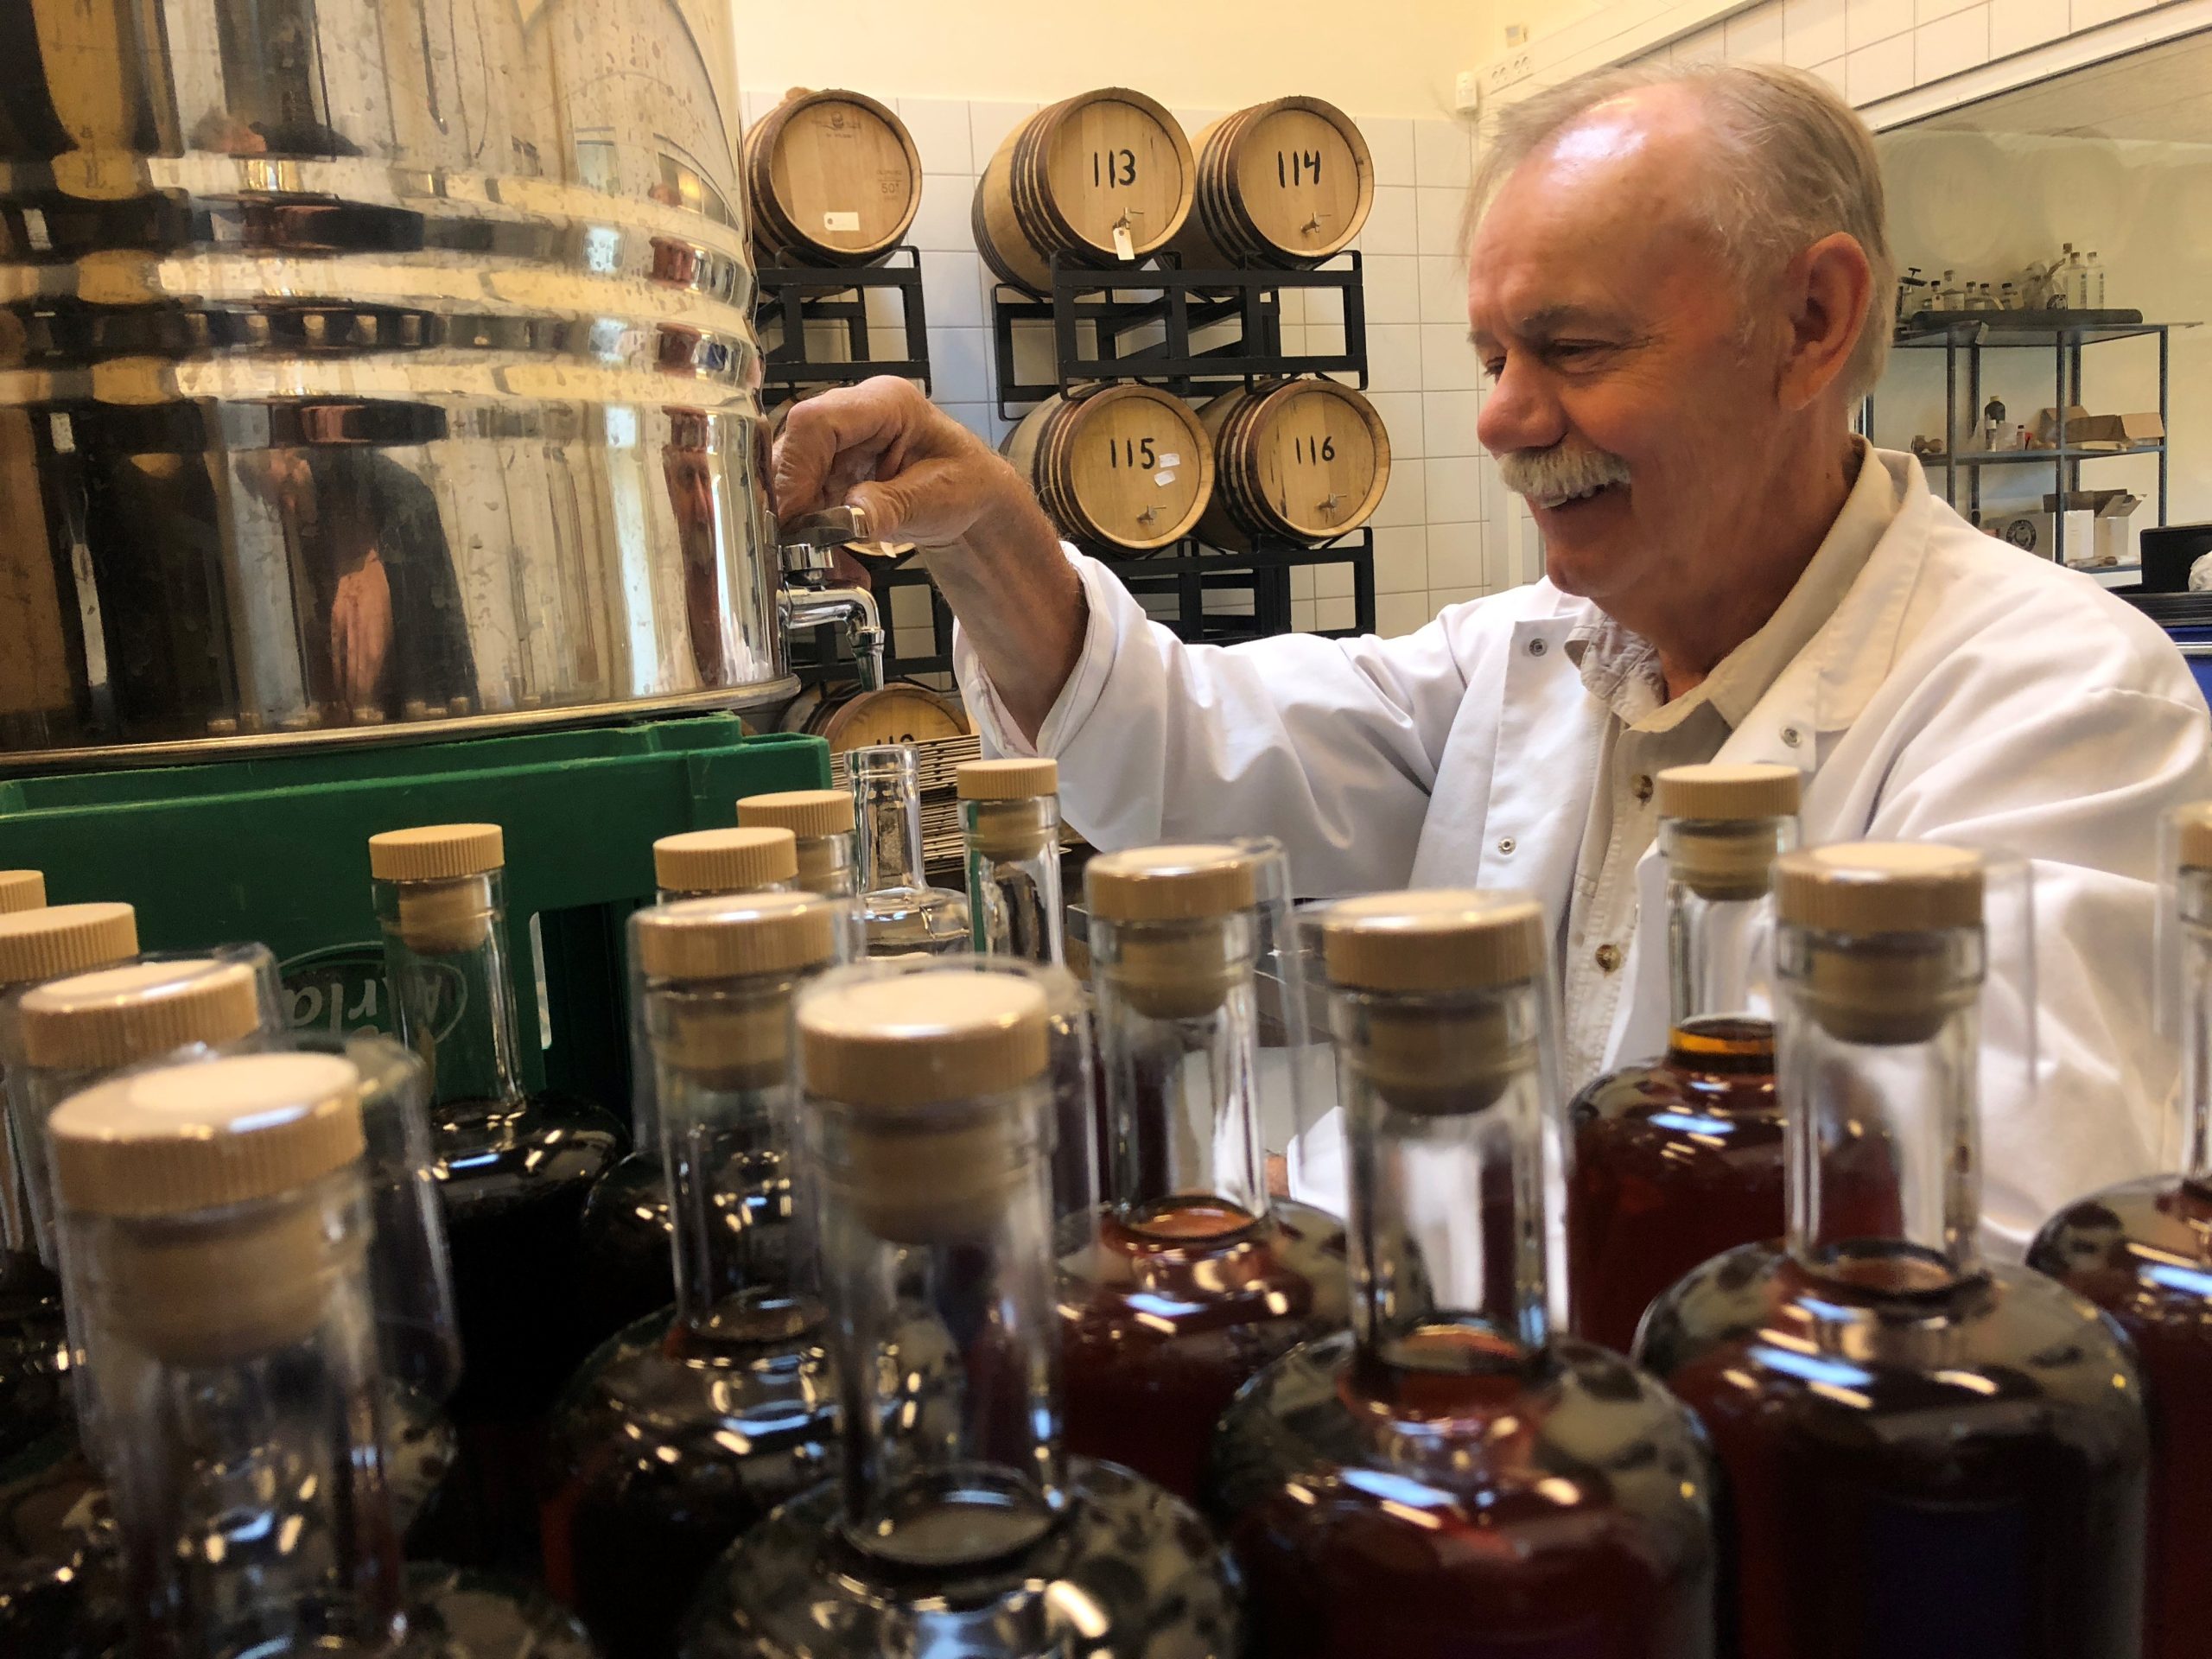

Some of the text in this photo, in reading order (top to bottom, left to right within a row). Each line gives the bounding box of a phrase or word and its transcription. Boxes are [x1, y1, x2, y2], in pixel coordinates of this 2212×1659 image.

[1094, 149, 1136, 188] 113
[1278, 149, 1320, 188] 114
[1110, 437, 1155, 469] 115
[1296, 435, 1335, 466] 116
